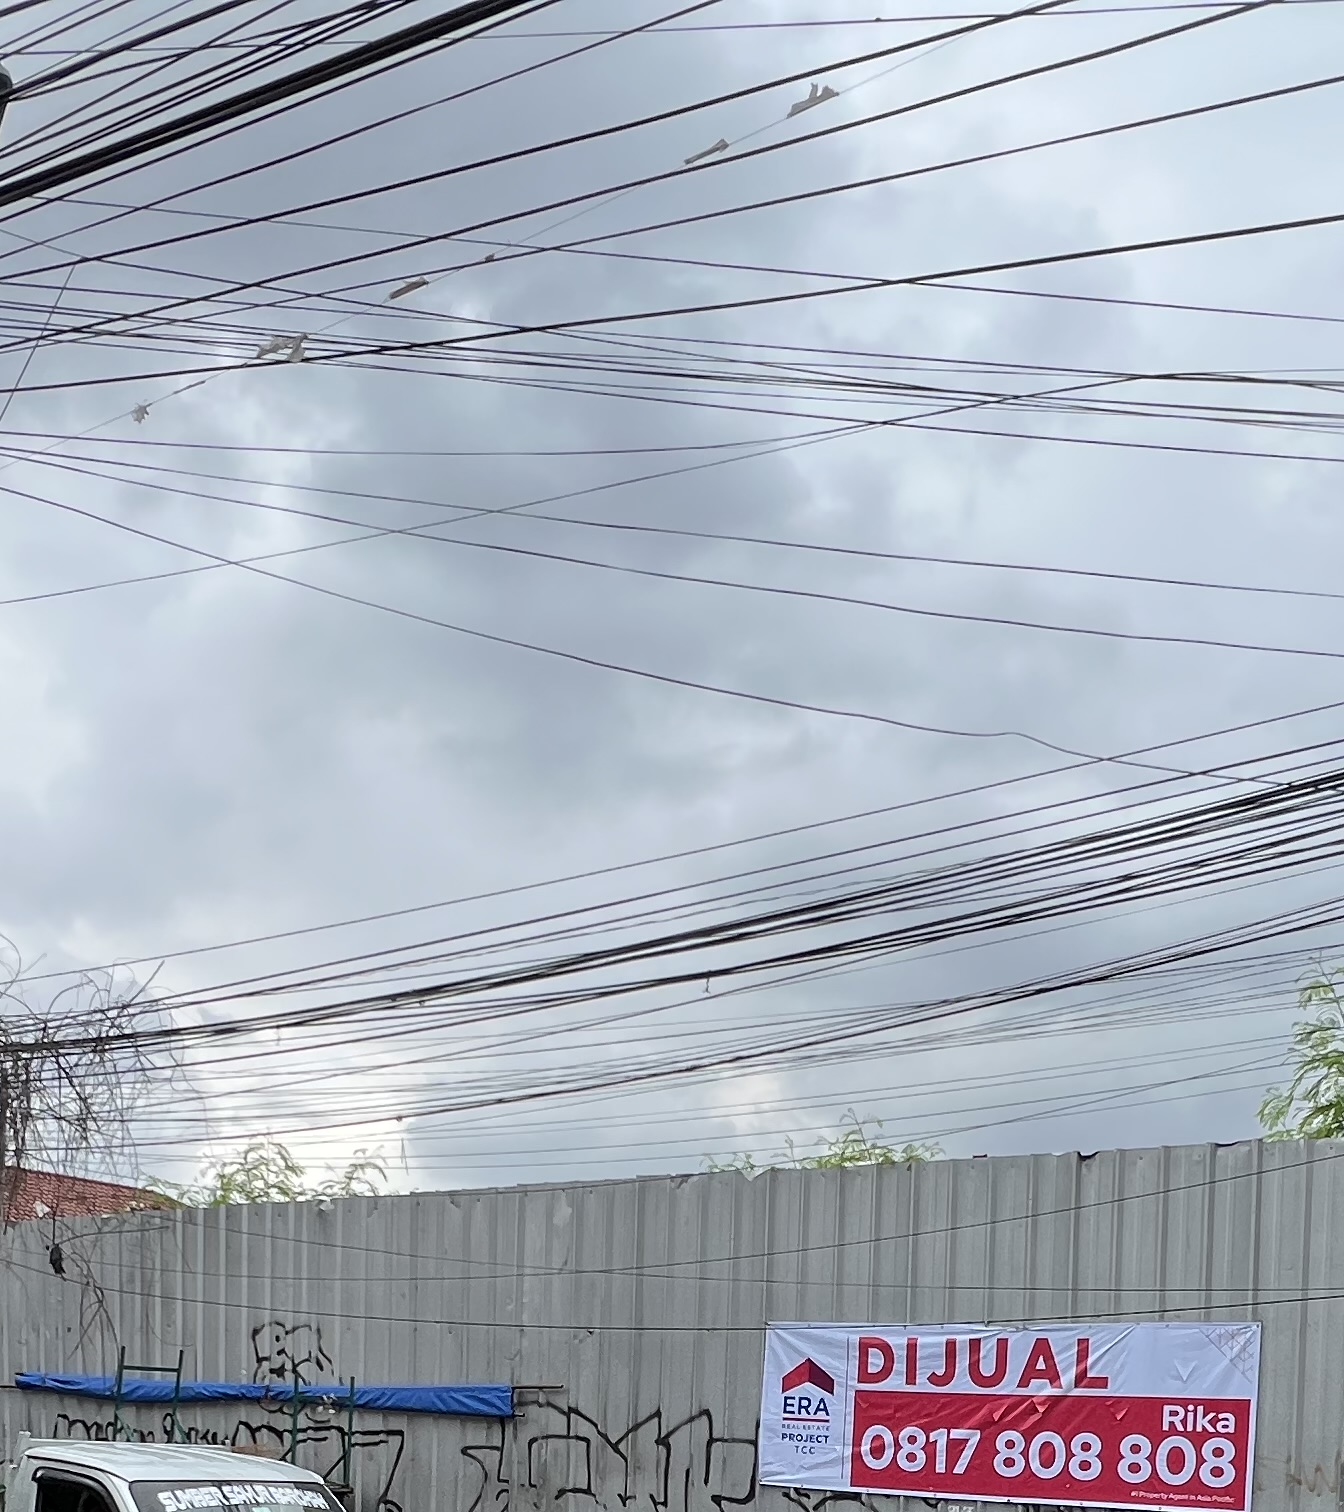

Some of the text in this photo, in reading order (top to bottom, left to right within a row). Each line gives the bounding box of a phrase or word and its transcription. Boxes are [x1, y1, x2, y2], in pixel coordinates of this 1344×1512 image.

[857, 1336, 1109, 1389] DIJUAL
[783, 1396, 830, 1416] ERA
[1162, 1404, 1236, 1434] Rika
[781, 1432, 830, 1444] PROJECT
[794, 1445, 816, 1455] TCC
[860, 1424, 981, 1475] 0817
[992, 1429, 1103, 1482] 808
[1117, 1433, 1236, 1489] 808
[157, 1485, 230, 1512] SUMBER
